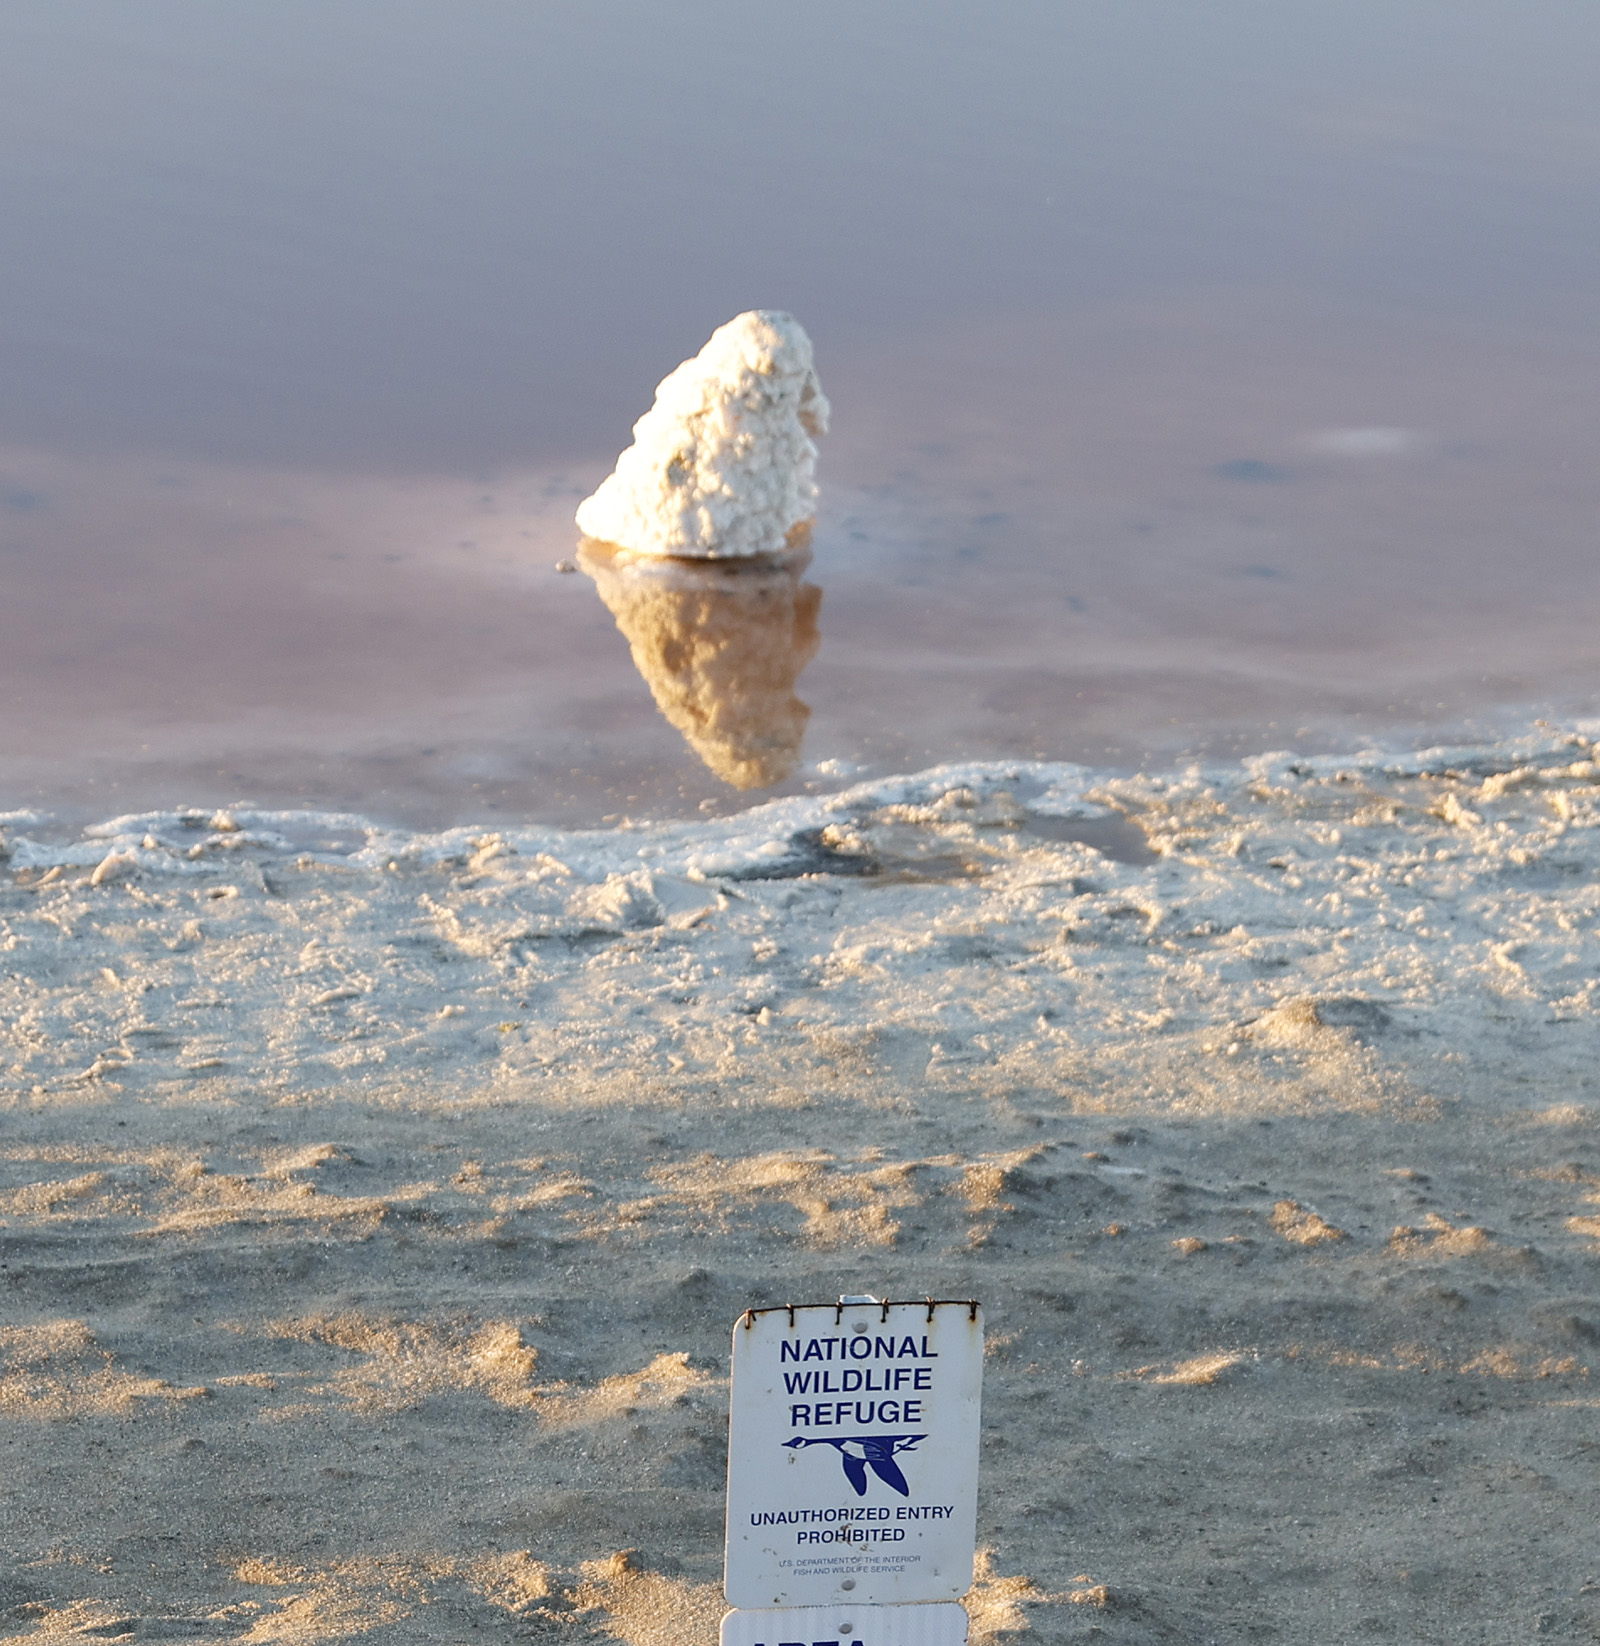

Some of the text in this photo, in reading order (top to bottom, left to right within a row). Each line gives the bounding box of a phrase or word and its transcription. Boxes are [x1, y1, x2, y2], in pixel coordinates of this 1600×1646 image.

[780, 1335, 938, 1363] NATIONAL
[783, 1367, 933, 1395] WILDLIFE
[791, 1400, 922, 1427] REFUGE
[750, 1505, 955, 1526] UNAUTHORIZED ENTRY
[797, 1528, 905, 1545] PROHIBITED
[793, 1565, 905, 1576] FISH AND WILDLIFE SERVICE
[796, 1557, 849, 1567] DEPARTMENT
[865, 1556, 880, 1564] THE
[883, 1555, 921, 1563] INTERIOR
